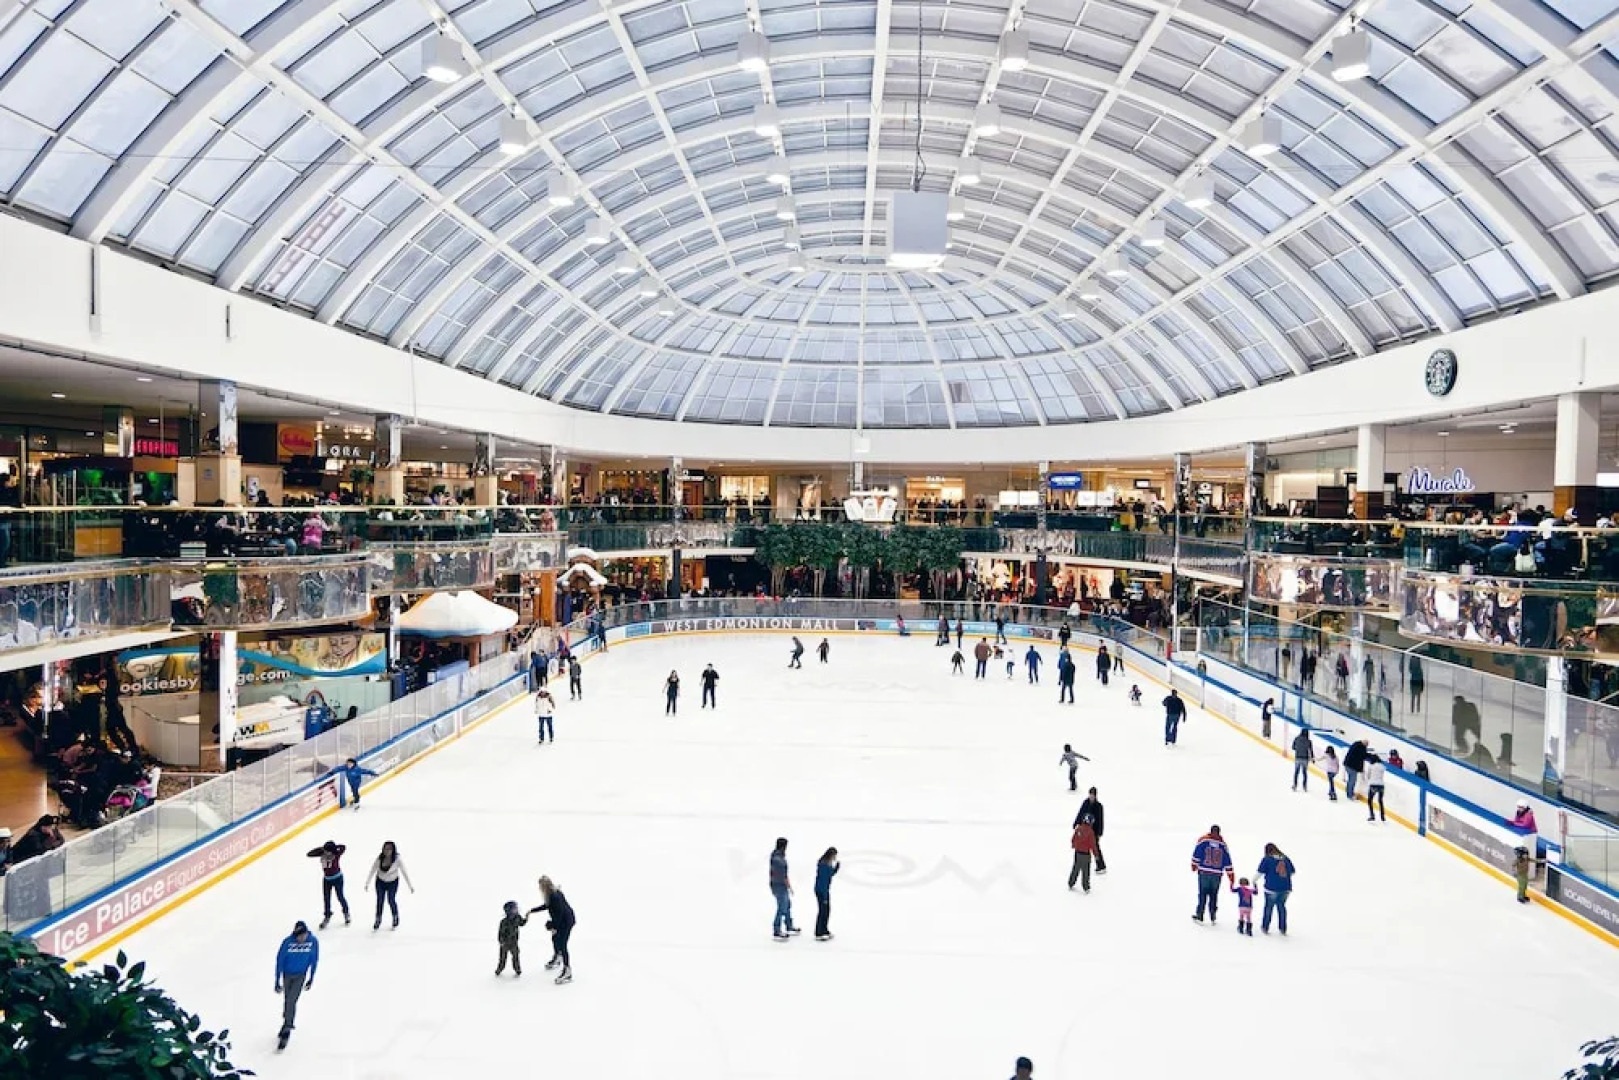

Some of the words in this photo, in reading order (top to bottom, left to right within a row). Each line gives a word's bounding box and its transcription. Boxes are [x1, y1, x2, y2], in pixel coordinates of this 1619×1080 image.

[1408, 466, 1475, 494] Murale
[664, 620, 699, 632] WEST
[706, 617, 793, 630] EDMONTON
[801, 618, 839, 630] MALL
[120, 675, 198, 693] ookiesby
[239, 721, 270, 735] WM
[54, 921, 90, 956] Ice
[96, 879, 165, 934] Palace
[166, 862, 206, 892] Figure
[208, 834, 249, 868] Skating
[250, 822, 274, 844] Club
